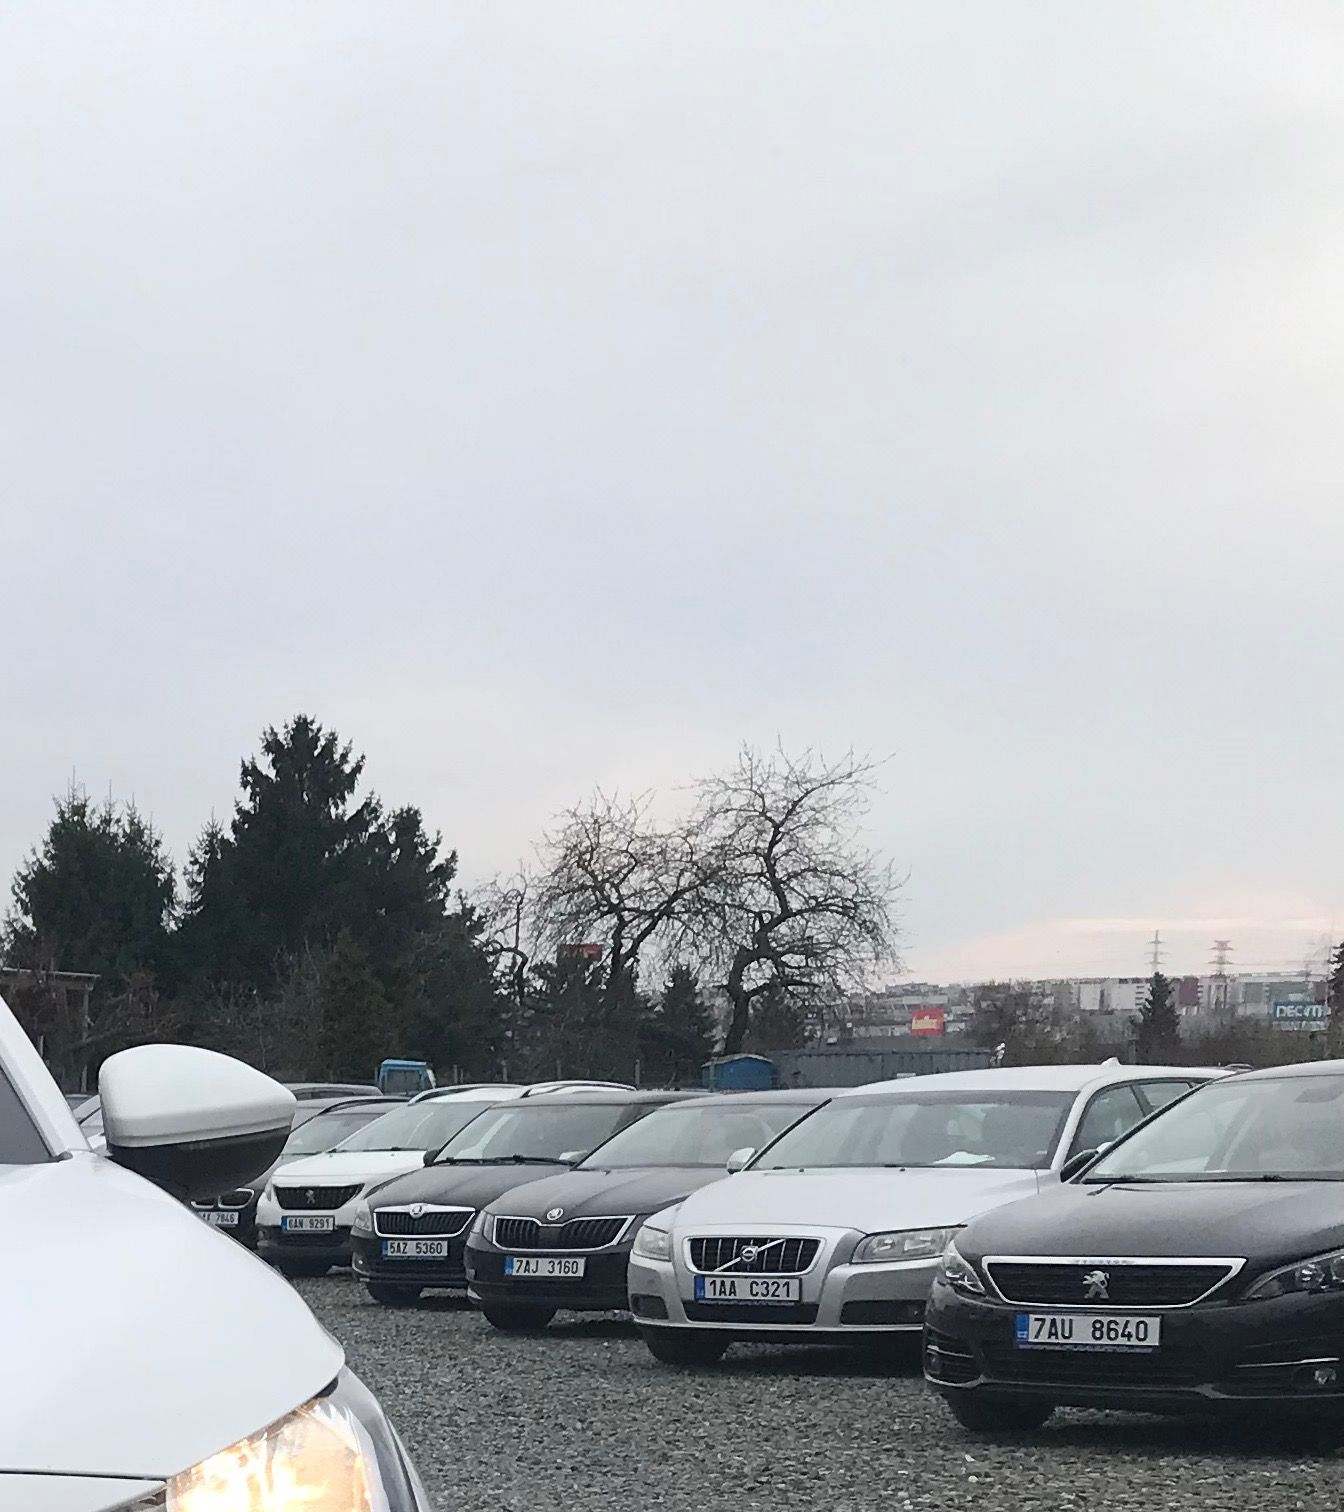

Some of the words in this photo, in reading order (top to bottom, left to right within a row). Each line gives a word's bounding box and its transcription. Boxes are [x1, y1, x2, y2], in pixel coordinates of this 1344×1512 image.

[389, 1242, 408, 1254] 5AZ
[415, 1242, 443, 1254] 5360
[515, 1260, 539, 1274] 7AJ
[547, 1260, 579, 1275] 3160
[709, 1280, 737, 1297] 1AA
[749, 1281, 790, 1298] C321
[1034, 1317, 1073, 1340] 7AU
[1091, 1319, 1148, 1342] 8640
